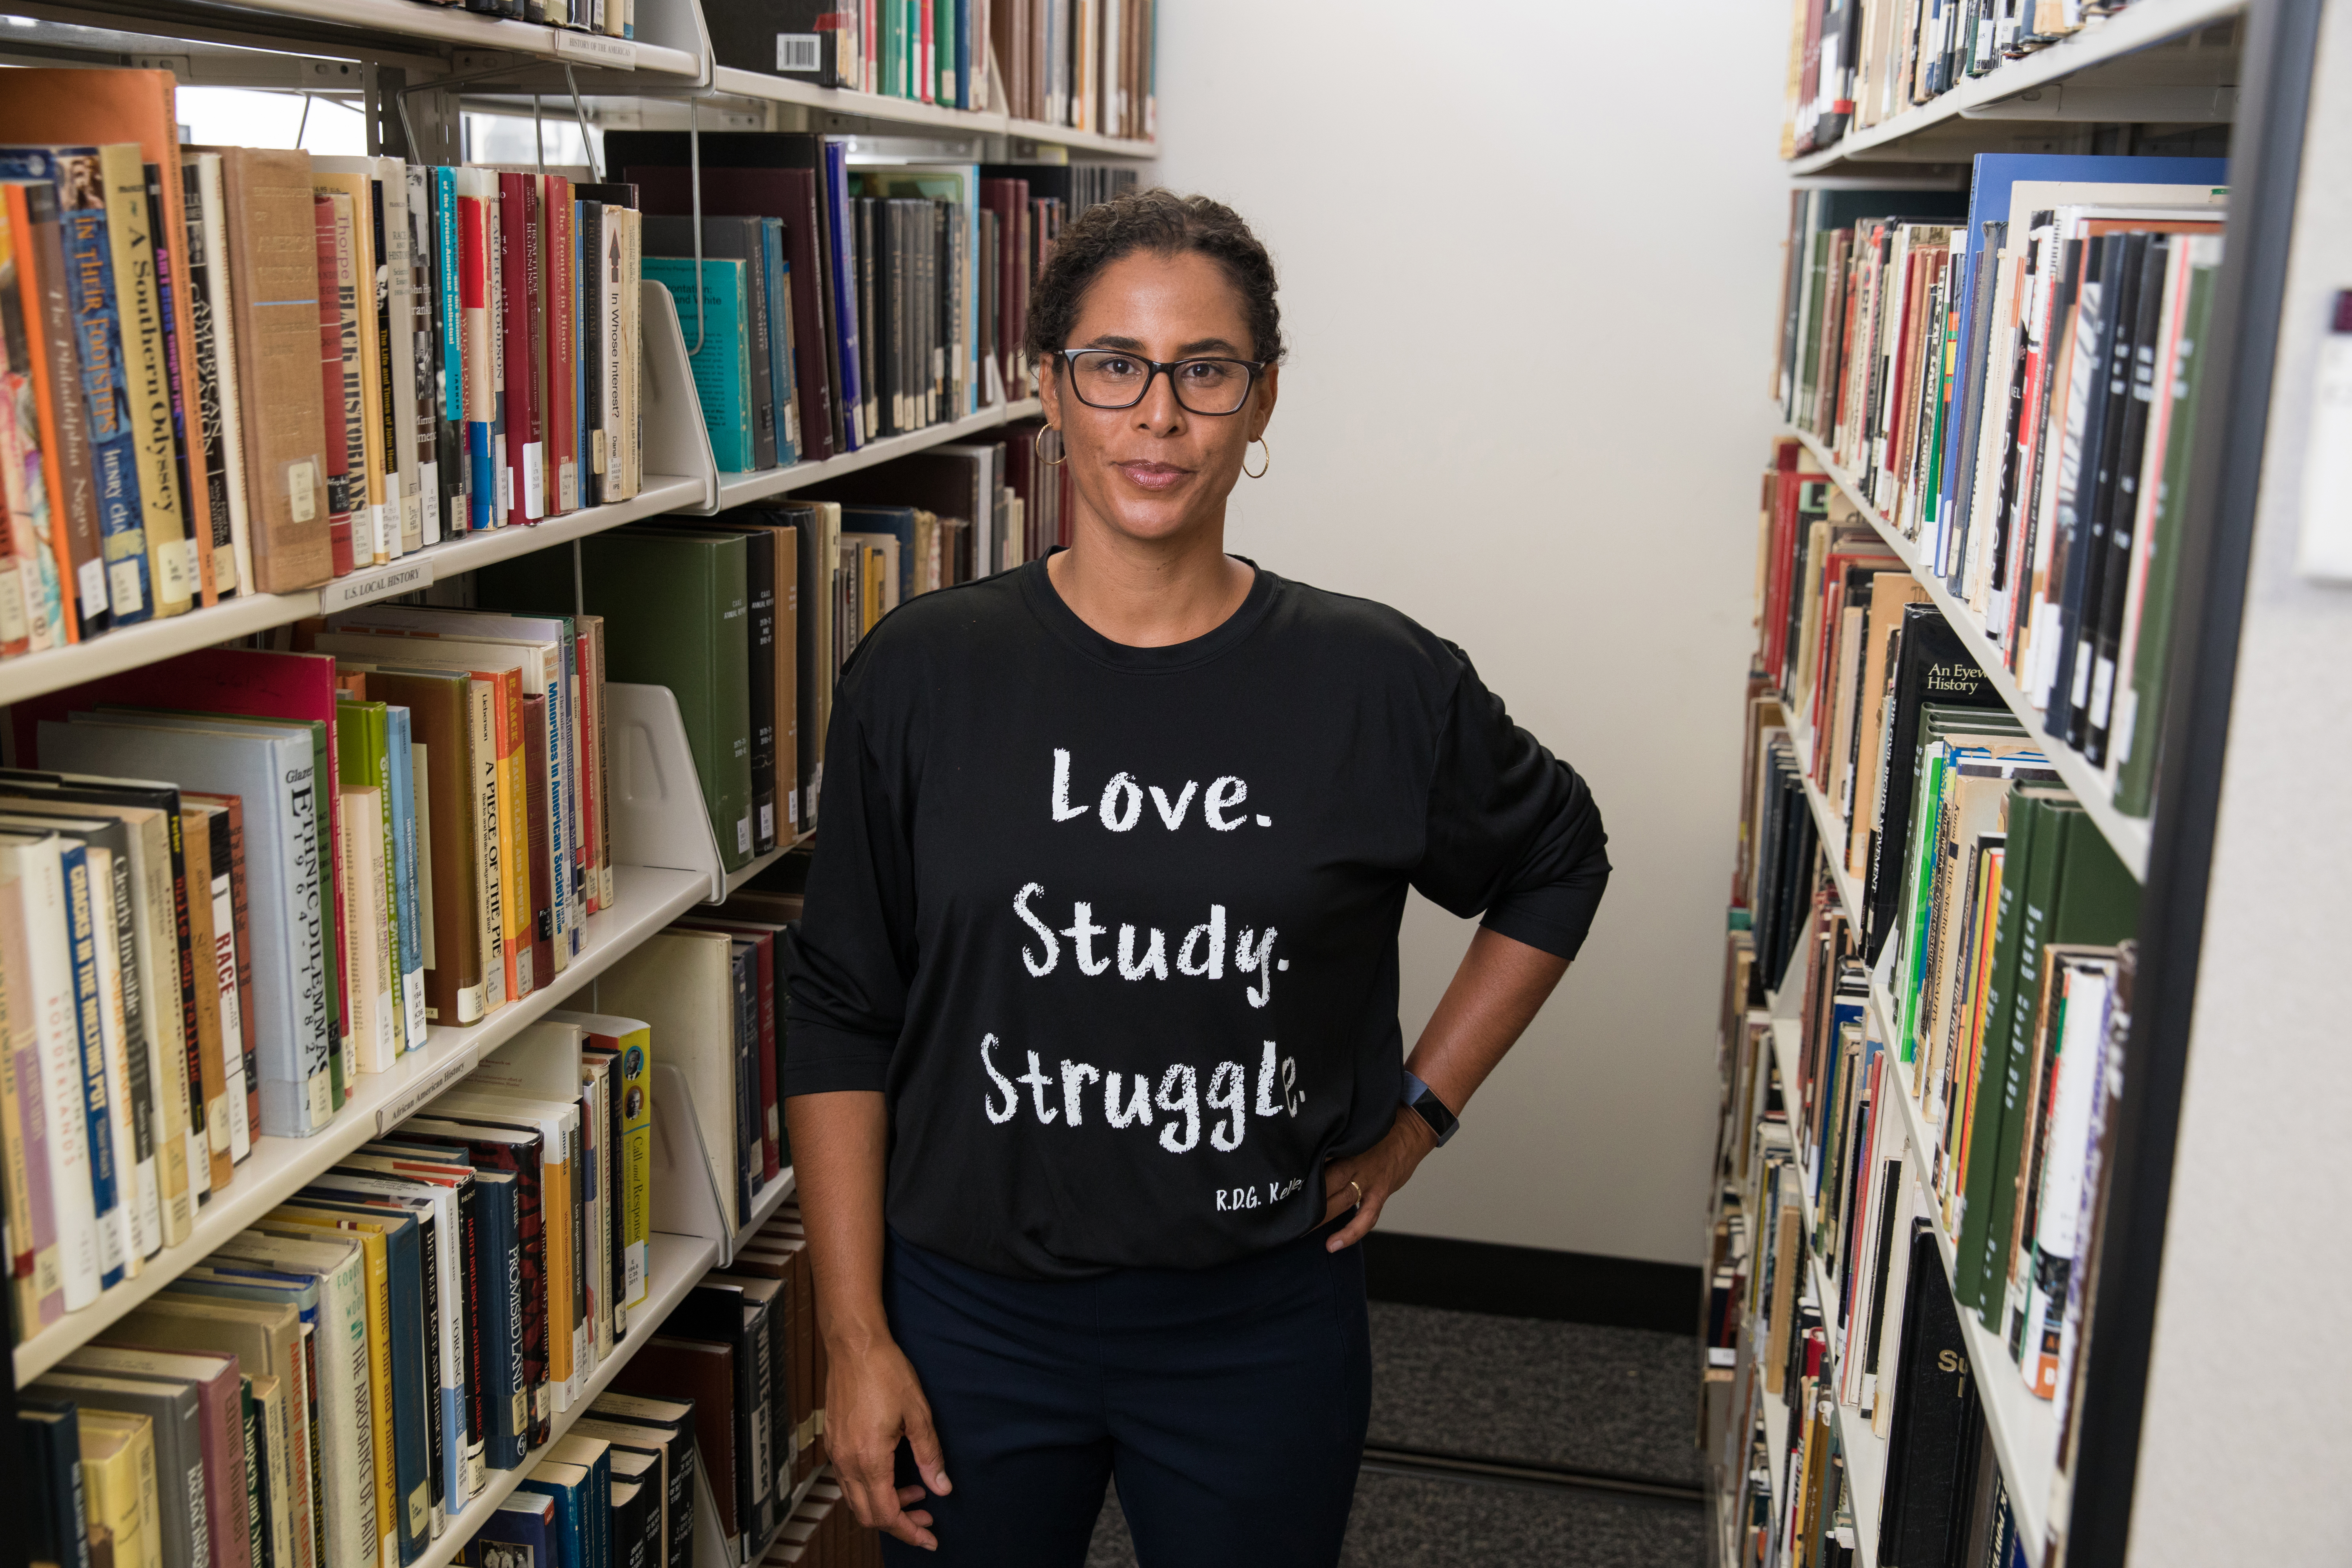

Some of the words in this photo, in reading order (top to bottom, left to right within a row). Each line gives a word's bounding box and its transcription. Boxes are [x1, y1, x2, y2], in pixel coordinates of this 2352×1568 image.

[570, 38, 589, 49] HISTORY
[591, 42, 597, 51] OF
[598, 43, 606, 52] THE
[608, 46, 630, 56] AMERICAS
[443, 180, 448, 190] of
[74, 216, 97, 240] IN
[128, 225, 147, 249] A
[337, 214, 350, 279] Thorpe
[74, 248, 105, 314] THEIR
[495, 279, 501, 294] G.
[561, 296, 567, 309] in
[612, 293, 619, 305] In
[132, 261, 159, 396] Southern
[339, 286, 359, 362] BLACK
[83, 317, 117, 433] FOOTSTEPS
[343, 373, 367, 511] HISTORIANS
[384, 416, 392, 426] of
[103, 449, 122, 499] HENRY
[145, 401, 174, 514] Odyssey
[345, 588, 358, 600] U.S.
[360, 579, 386, 595] LOCAL
[388, 568, 420, 587] HISTORY
[1927, 677, 1978, 695] History
[1928, 663, 1950, 677] An
[1954, 664, 1987, 681] Eyew
[510, 697, 518, 743] MACK
[548, 681, 559, 762] Minorities
[286, 766, 313, 784] Glazer
[380, 755, 389, 817] Ethnic
[486, 761, 494, 777] A
[551, 762, 560, 779] in
[1052, 748, 1272, 832] Love.
[1880, 767, 1890, 814] RIGHTS
[487, 780, 497, 840] PIECE
[552, 780, 562, 852] American
[1951, 804, 1960, 840] Karon
[383, 822, 395, 915] American
[489, 846, 498, 872] OF
[1871, 817, 1885, 893] MOVEMENT
[1938, 836, 1947, 868] Mark
[70, 864, 91, 939] CRACKS
[490, 878, 500, 920] THE
[554, 852, 564, 908] Society
[1937, 873, 1943, 889] of
[291, 782, 319, 911] ETHNIC
[309, 916, 329, 1073] DILEMMAS
[1928, 892, 1941, 966] Oppression
[1942, 892, 1950, 936] NEGRO
[76, 939, 93, 963] IN
[216, 931, 235, 999] RACE
[492, 925, 502, 958] PIE
[1014, 882, 1289, 1009] Study.
[79, 963, 96, 999] THE
[1931, 940, 1945, 1026] PERSONALITY
[414, 1016, 425, 1029] 2017
[415, 1001, 421, 1009] A1
[415, 1009, 423, 1019] K36
[82, 996, 103, 1077] MELTING
[89, 1073, 107, 1112] POT
[392, 1099, 414, 1121] African
[416, 1079, 443, 1104] American
[444, 1062, 465, 1082] History
[981, 1033, 1305, 1153] Struggle.
[633, 1136, 643, 1162] Call
[461, 1189, 475, 1203] HUNT
[633, 1164, 641, 1182] and
[631, 1183, 643, 1242] Response
[1216, 1186, 1261, 1211] R.D.G.
[470, 1256, 478, 1313] INFLUENCE
[509, 1248, 522, 1343] PROMISED
[542, 1290, 548, 1309] My
[628, 1278, 639, 1286] 2011
[380, 1279, 389, 1335] Ethnic
[472, 1314, 478, 1326] ON
[352, 1339, 366, 1381] THE
[382, 1339, 391, 1378] Film
[427, 1229, 436, 1306] BETWEEN
[433, 1384, 442, 1458] ETHNICITY
[453, 1317, 462, 1385] FORGING
[473, 1329, 482, 1395] ANTEBELLUM
[290, 1341, 303, 1425] AMERICAN
[512, 1347, 523, 1394] LAND
[384, 1384, 392, 1414] and
[354, 1380, 372, 1484] ARROGANCE
[386, 1416, 395, 1489] Filmstrip
[759, 1408, 770, 1493] BLACK
[294, 1428, 307, 1507] MINORITY
[360, 1481, 373, 1506] OF
[361, 1506, 376, 1561] FAITH
